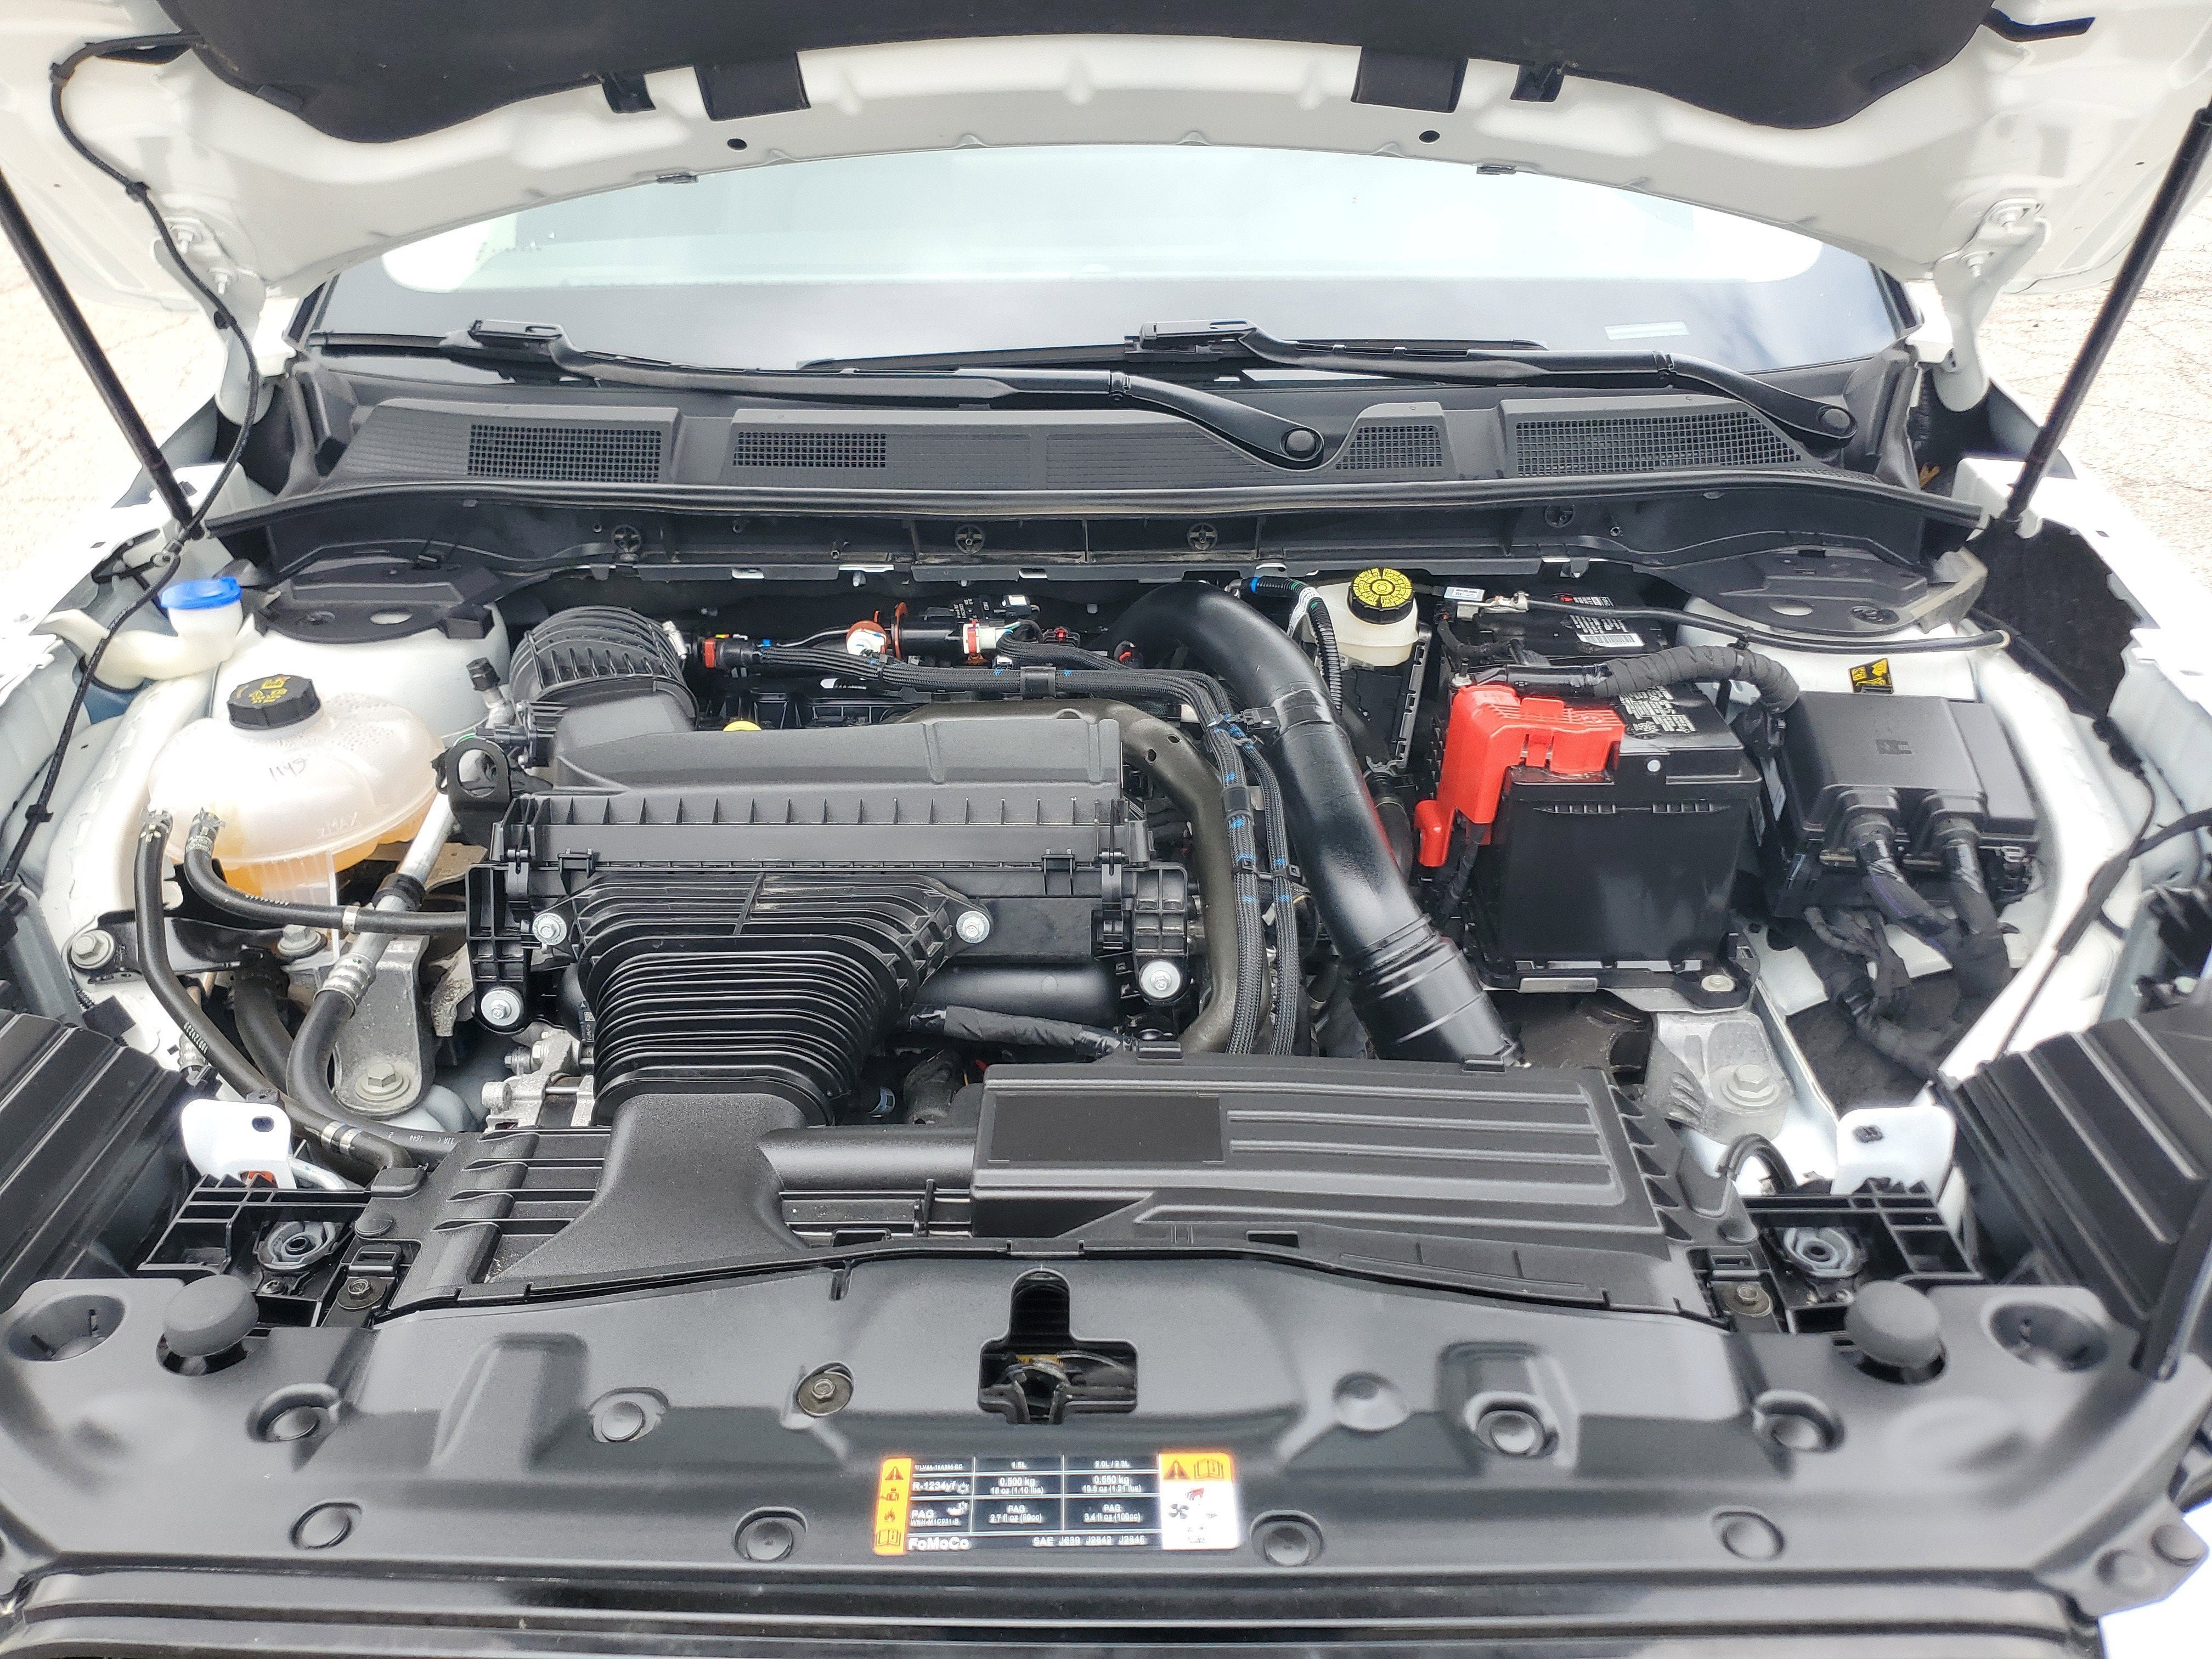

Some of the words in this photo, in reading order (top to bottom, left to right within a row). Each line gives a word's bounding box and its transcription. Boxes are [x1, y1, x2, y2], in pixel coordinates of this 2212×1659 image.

[999, 1477, 1022, 1486] 0.500
[1024, 1476, 1035, 1487] kg
[1093, 1475, 1116, 1484] 0.550
[1118, 1475, 1130, 1485] kg
[912, 1481, 956, 1492] R-1234yf
[1030, 1486, 1043, 1494] lbs)
[911, 1509, 934, 1519] PAG
[1007, 1505, 1025, 1513] PAG
[909, 1537, 969, 1550] FoMoCo
